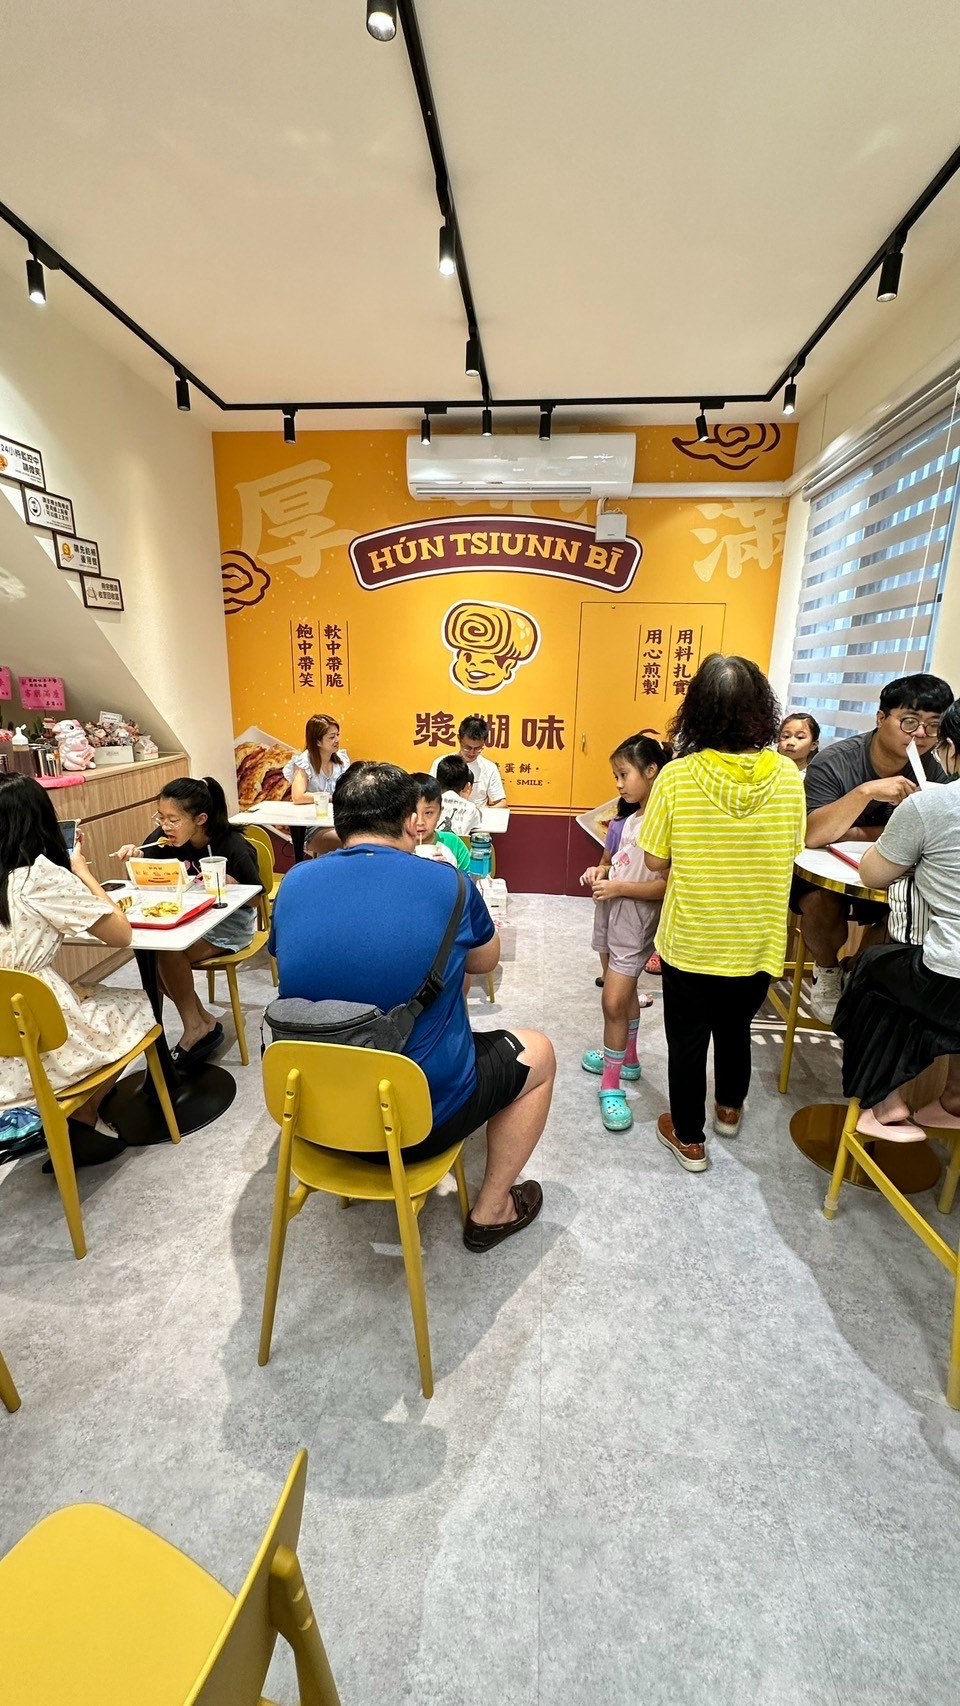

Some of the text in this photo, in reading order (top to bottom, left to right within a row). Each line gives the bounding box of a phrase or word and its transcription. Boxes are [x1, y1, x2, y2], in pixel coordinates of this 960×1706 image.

[233, 459, 361, 578] 厚
[368, 532, 624, 575] HÚN TSIUNN BĪ
[296, 623, 315, 688] 飽中帶笑
[324, 624, 344, 688] 軟中帶脆
[641, 629, 663, 695] 用心煎製
[673, 629, 694, 696] 用料扎實
[495, 762, 532, 774] 蛋餅
